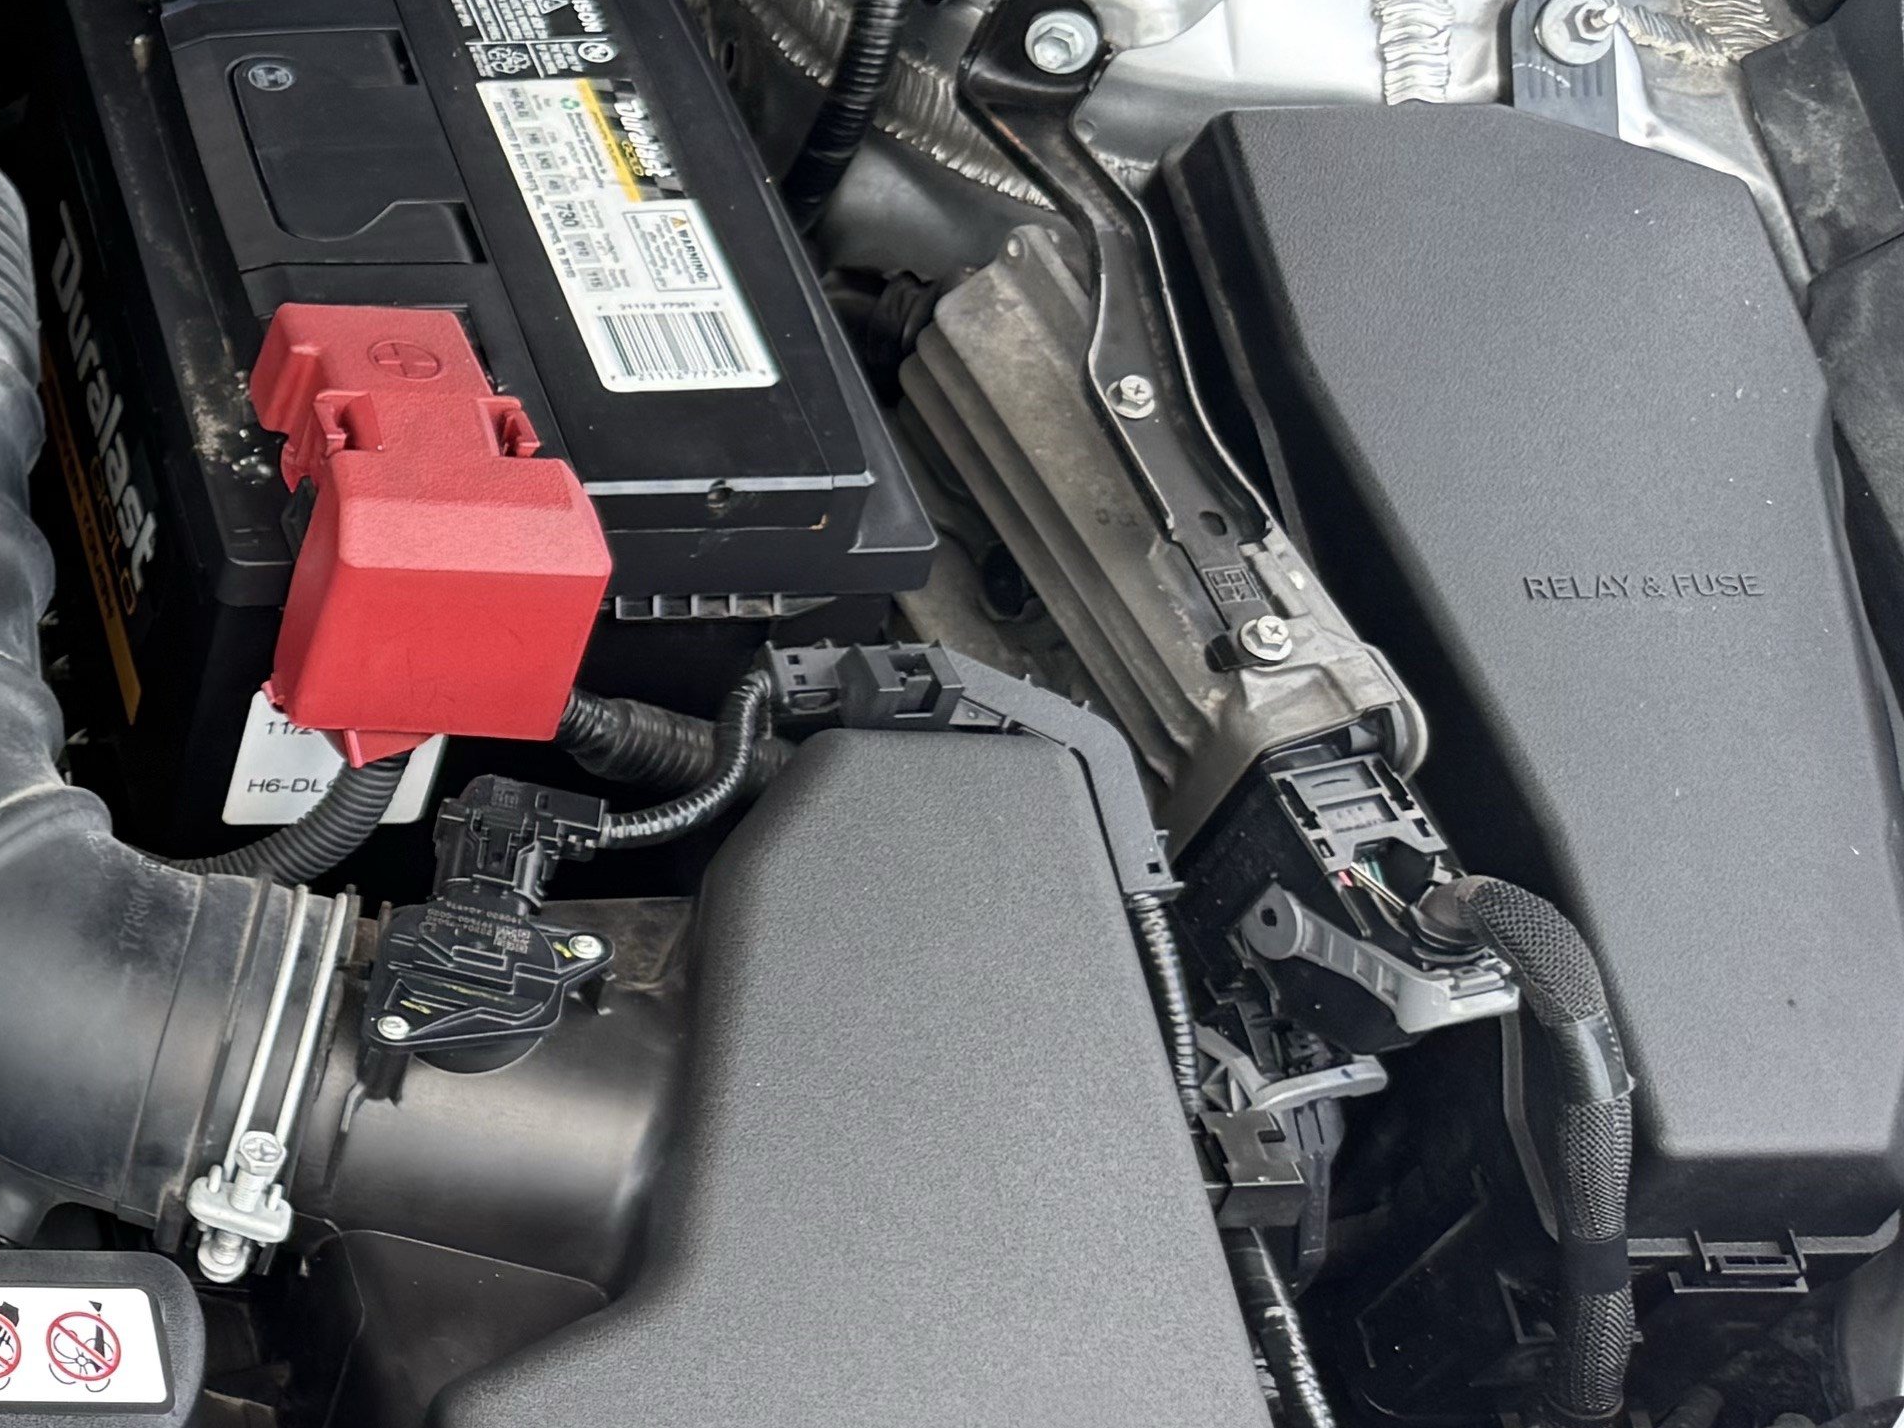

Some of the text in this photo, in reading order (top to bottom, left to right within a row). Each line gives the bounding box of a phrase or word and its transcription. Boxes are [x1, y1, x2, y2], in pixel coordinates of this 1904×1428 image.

[614, 100, 673, 178] Duralast
[553, 203, 580, 228] 730
[677, 229, 709, 283] WARNING:
[52, 202, 158, 593] Duralast
[1522, 572, 1766, 600] RELAY & FUSE
